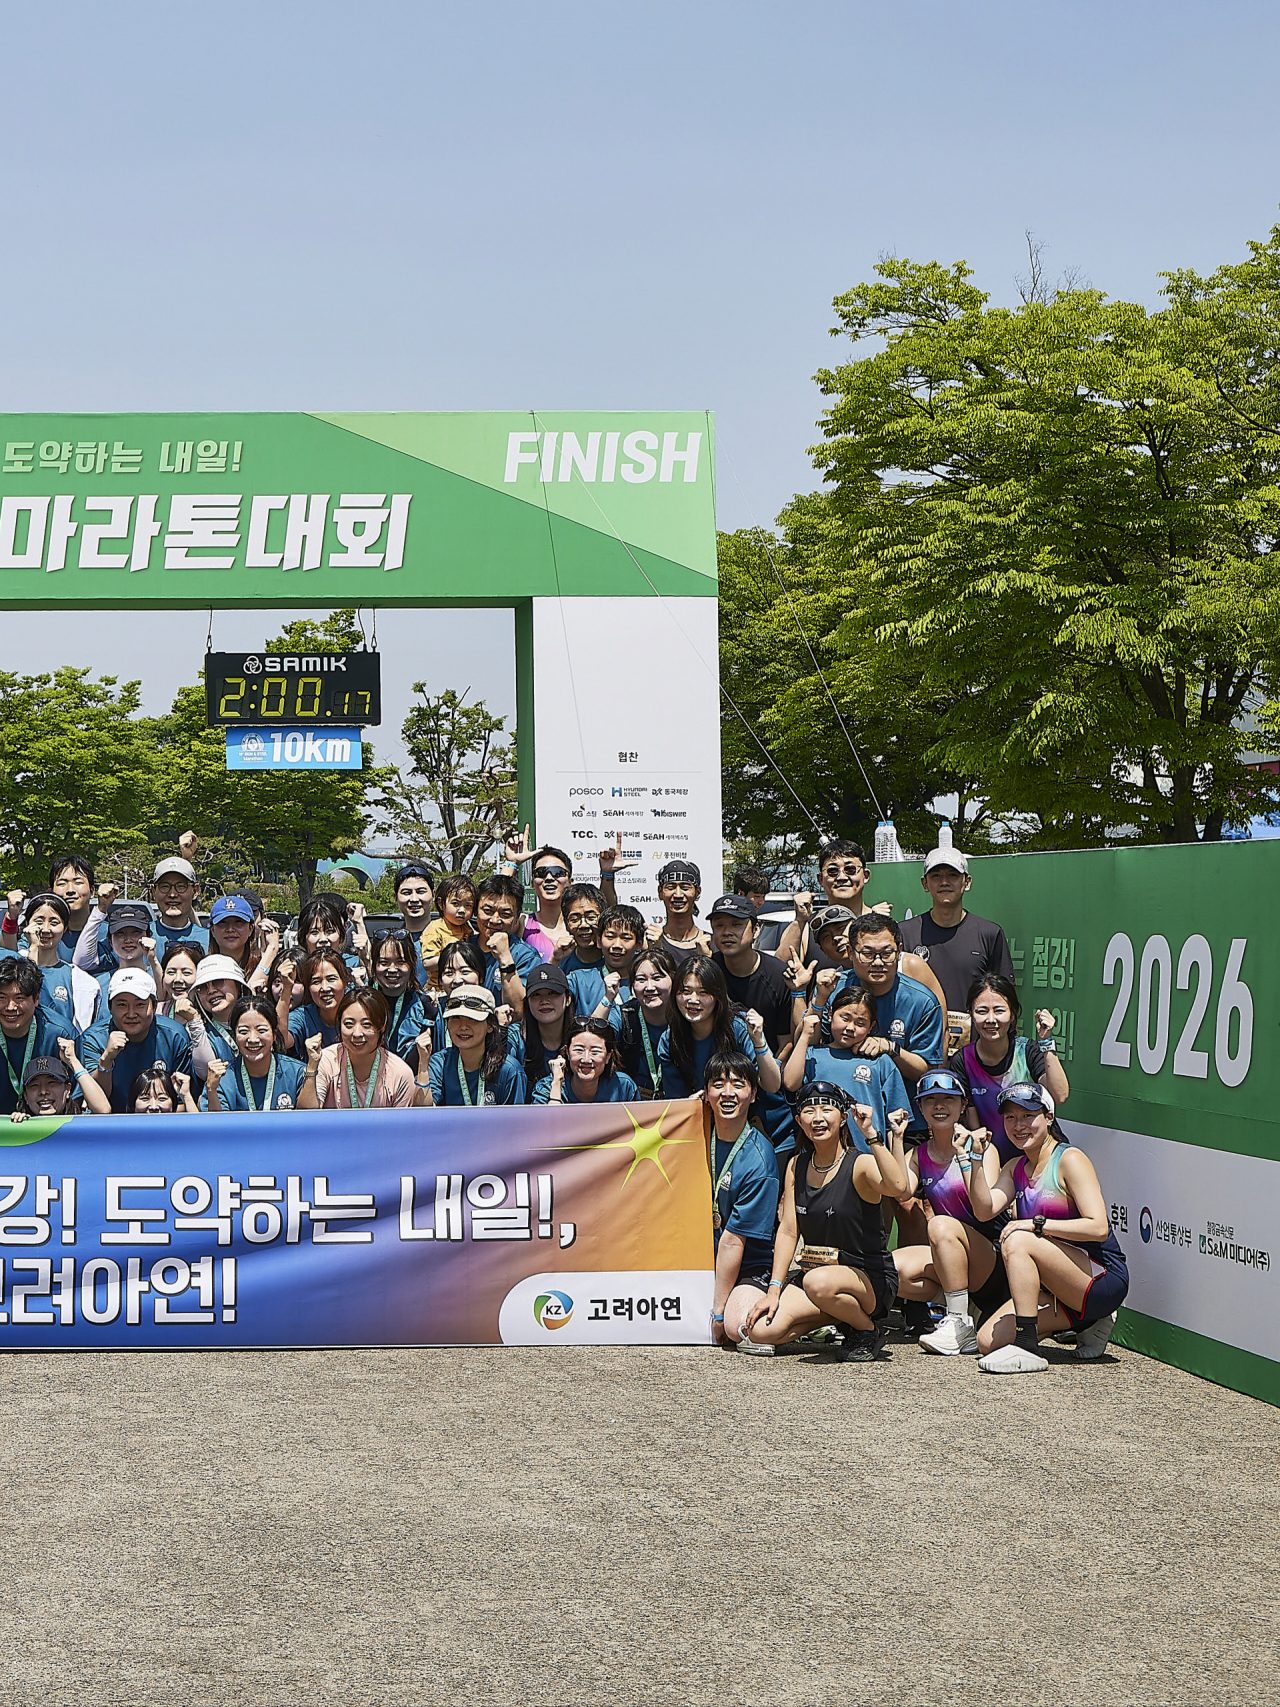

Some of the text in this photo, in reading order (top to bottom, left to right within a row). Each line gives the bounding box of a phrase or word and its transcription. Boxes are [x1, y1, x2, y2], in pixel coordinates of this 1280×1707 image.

[3, 440, 144, 474] 도약하는
[159, 440, 243, 474] 내일!
[504, 431, 703, 483] FINISH
[264, 656, 348, 672] SAMIK
[271, 732, 351, 763] 10km
[618, 751, 639, 763] 협찬
[571, 830, 594, 839] TCC
[1033, 936, 1076, 989] 철강!
[1100, 932, 1254, 1088] 2026
[102, 1174, 377, 1247] 도약하는
[400, 1172, 578, 1250] 내일!,
[1156, 1220, 1193, 1248] 산업통상부
[545, 1305, 562, 1316] KZ
[587, 1297, 682, 1321] 고려아연
